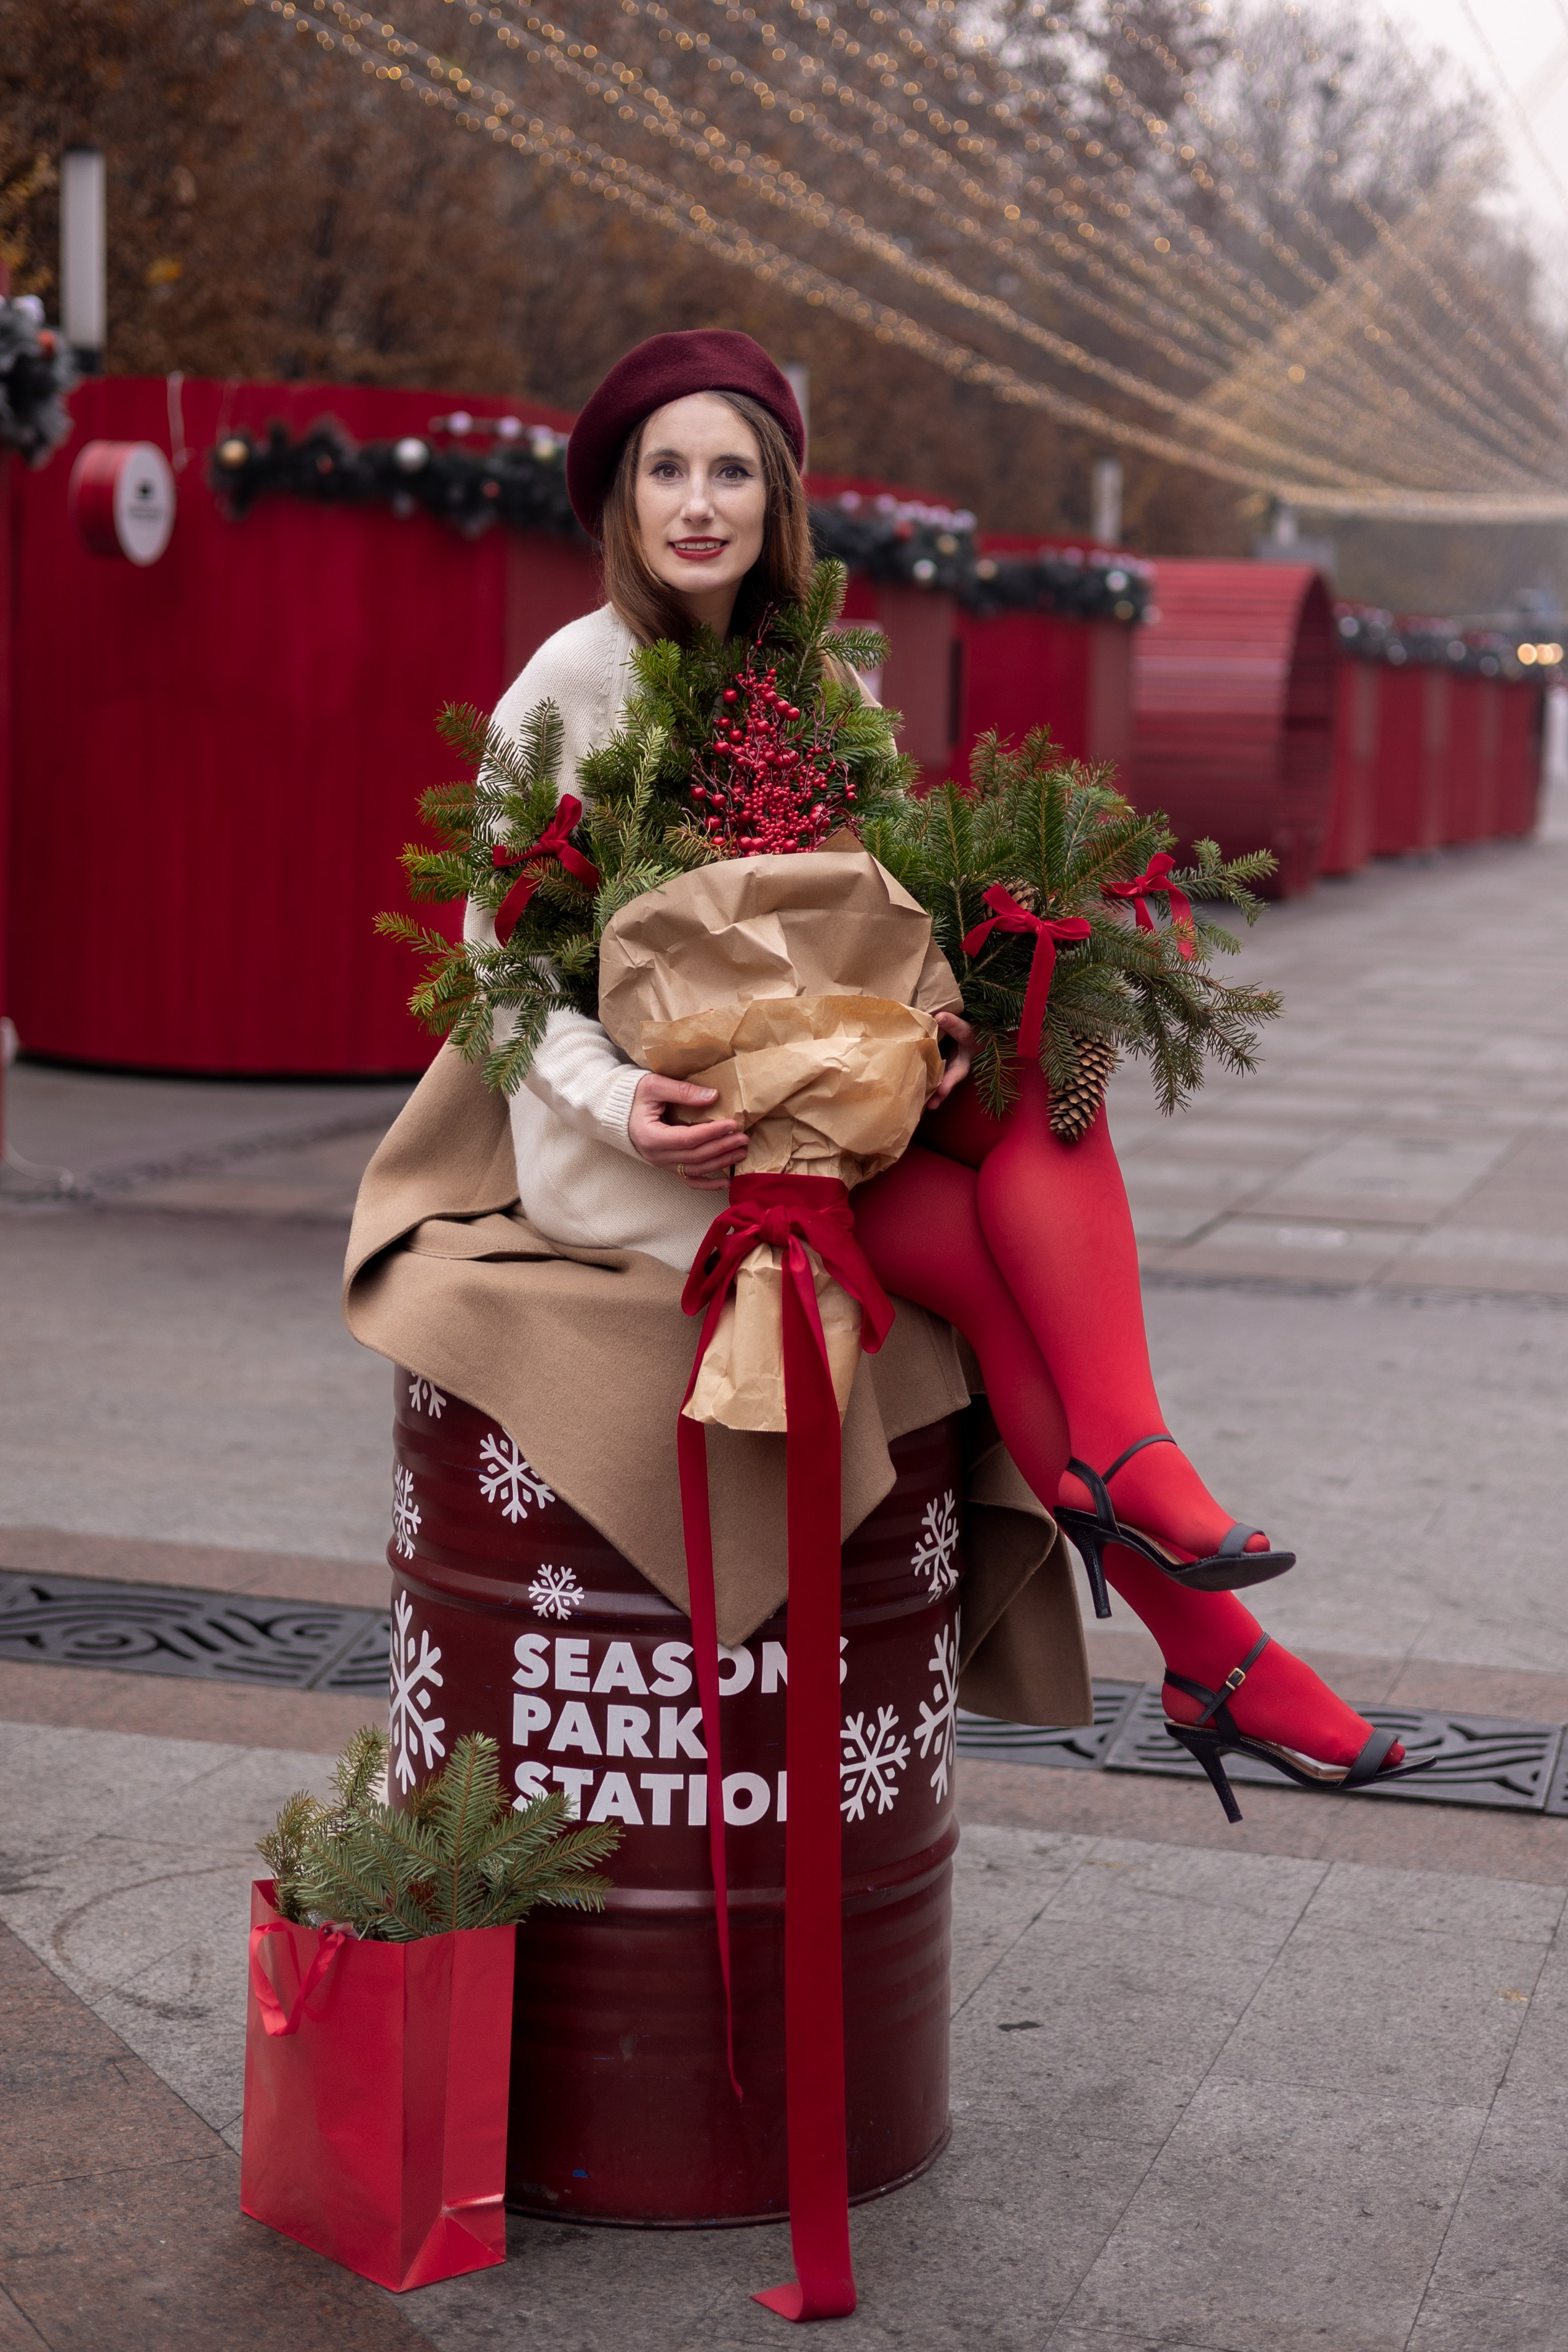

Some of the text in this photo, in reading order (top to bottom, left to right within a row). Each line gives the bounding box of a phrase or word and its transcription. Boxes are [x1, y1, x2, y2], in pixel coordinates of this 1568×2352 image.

[512, 1633, 848, 1696] SEASON
[513, 1693, 707, 1758] PARK
[512, 1762, 787, 1826] STATIO
